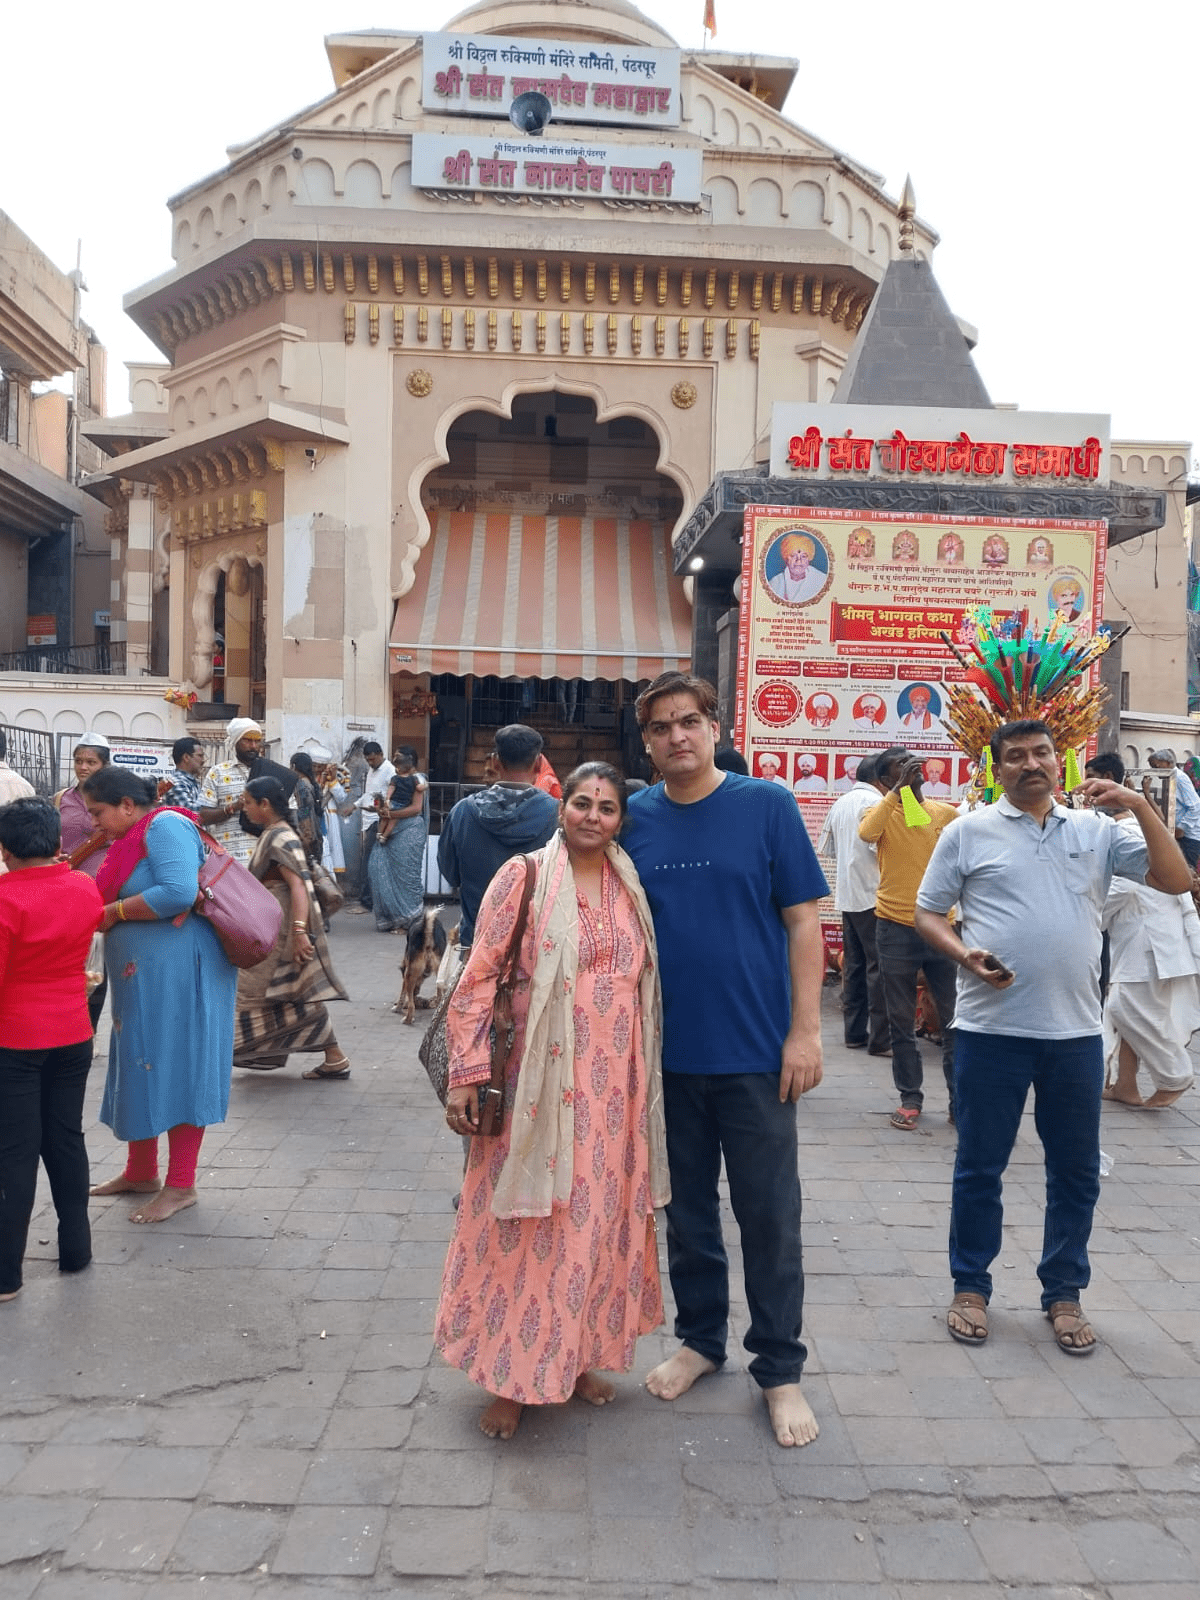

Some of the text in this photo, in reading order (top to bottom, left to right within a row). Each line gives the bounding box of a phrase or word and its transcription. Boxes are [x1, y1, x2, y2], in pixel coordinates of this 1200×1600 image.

[448, 41, 463, 60] श्री
[467, 42, 498, 64] विठ्ठल
[500, 45, 546, 66] रुक्मिणी
[622, 55, 656, 79] पंढरपूर
[434, 64, 463, 98] श्री
[466, 65, 505, 100] संत
[591, 81, 672, 114] महाद्वार
[442, 149, 675, 197] श्री संत नामदेव पायरी
[787, 426, 1103, 481] श्री संत चोखामेळा समाधी
[931, 585, 961, 595] महाराज
[870, 623, 904, 638] अखंड
[878, 608, 923, 623] भागवत
